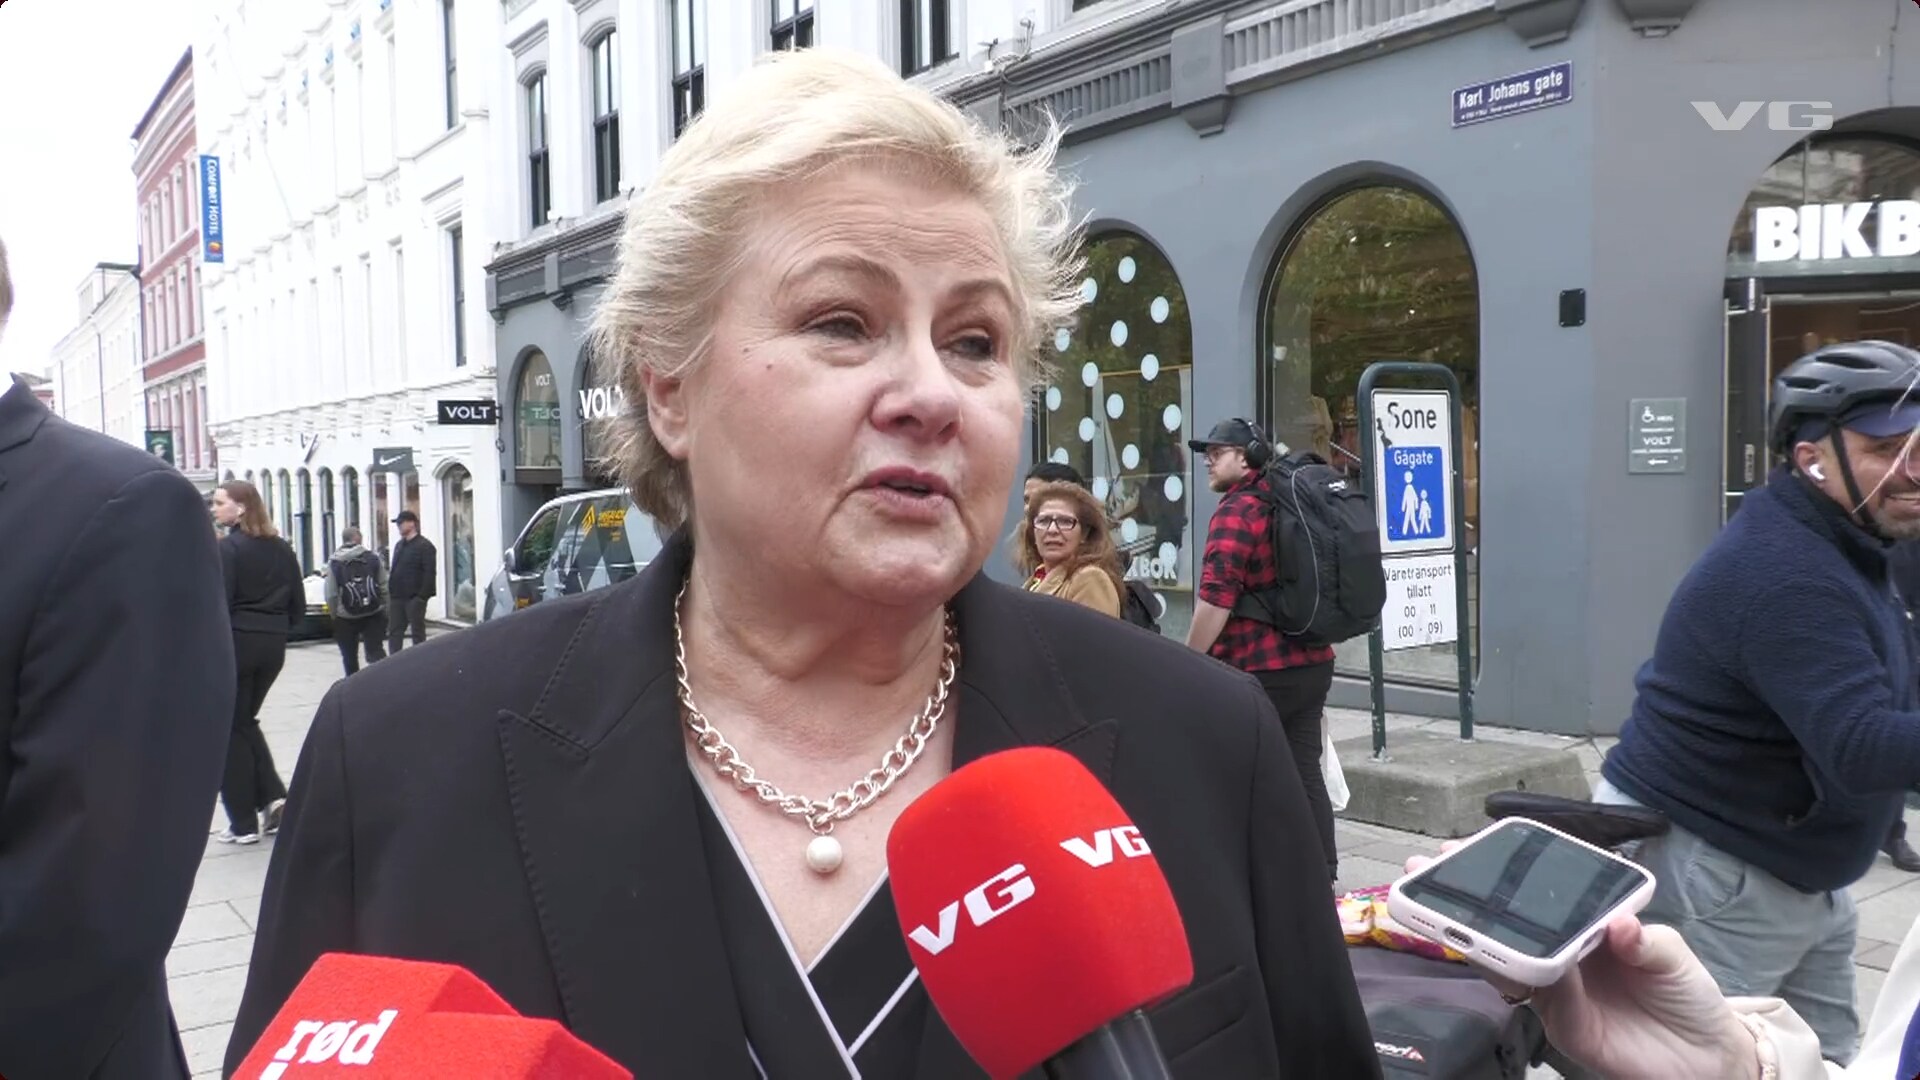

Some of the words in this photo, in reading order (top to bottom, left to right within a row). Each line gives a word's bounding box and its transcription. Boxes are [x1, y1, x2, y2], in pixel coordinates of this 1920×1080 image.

[1460, 88, 1483, 109] Karl
[1489, 80, 1530, 103] Johans
[1535, 70, 1563, 96] gate
[534, 373, 550, 387] VOLT
[446, 406, 491, 419] VOLT
[1387, 401, 1437, 429] Sone
[1643, 436, 1672, 445] VOLT
[1394, 449, 1433, 469] Gågate
[1383, 564, 1451, 582] Varetransport
[1407, 584, 1432, 599] tillatt
[1403, 605, 1416, 618] 00
[1398, 624, 1414, 639] (00
[1427, 620, 1443, 635] 09)
[1058, 825, 1151, 868] VG
[908, 863, 1036, 956] VG
[274, 1009, 399, 1065] rød
